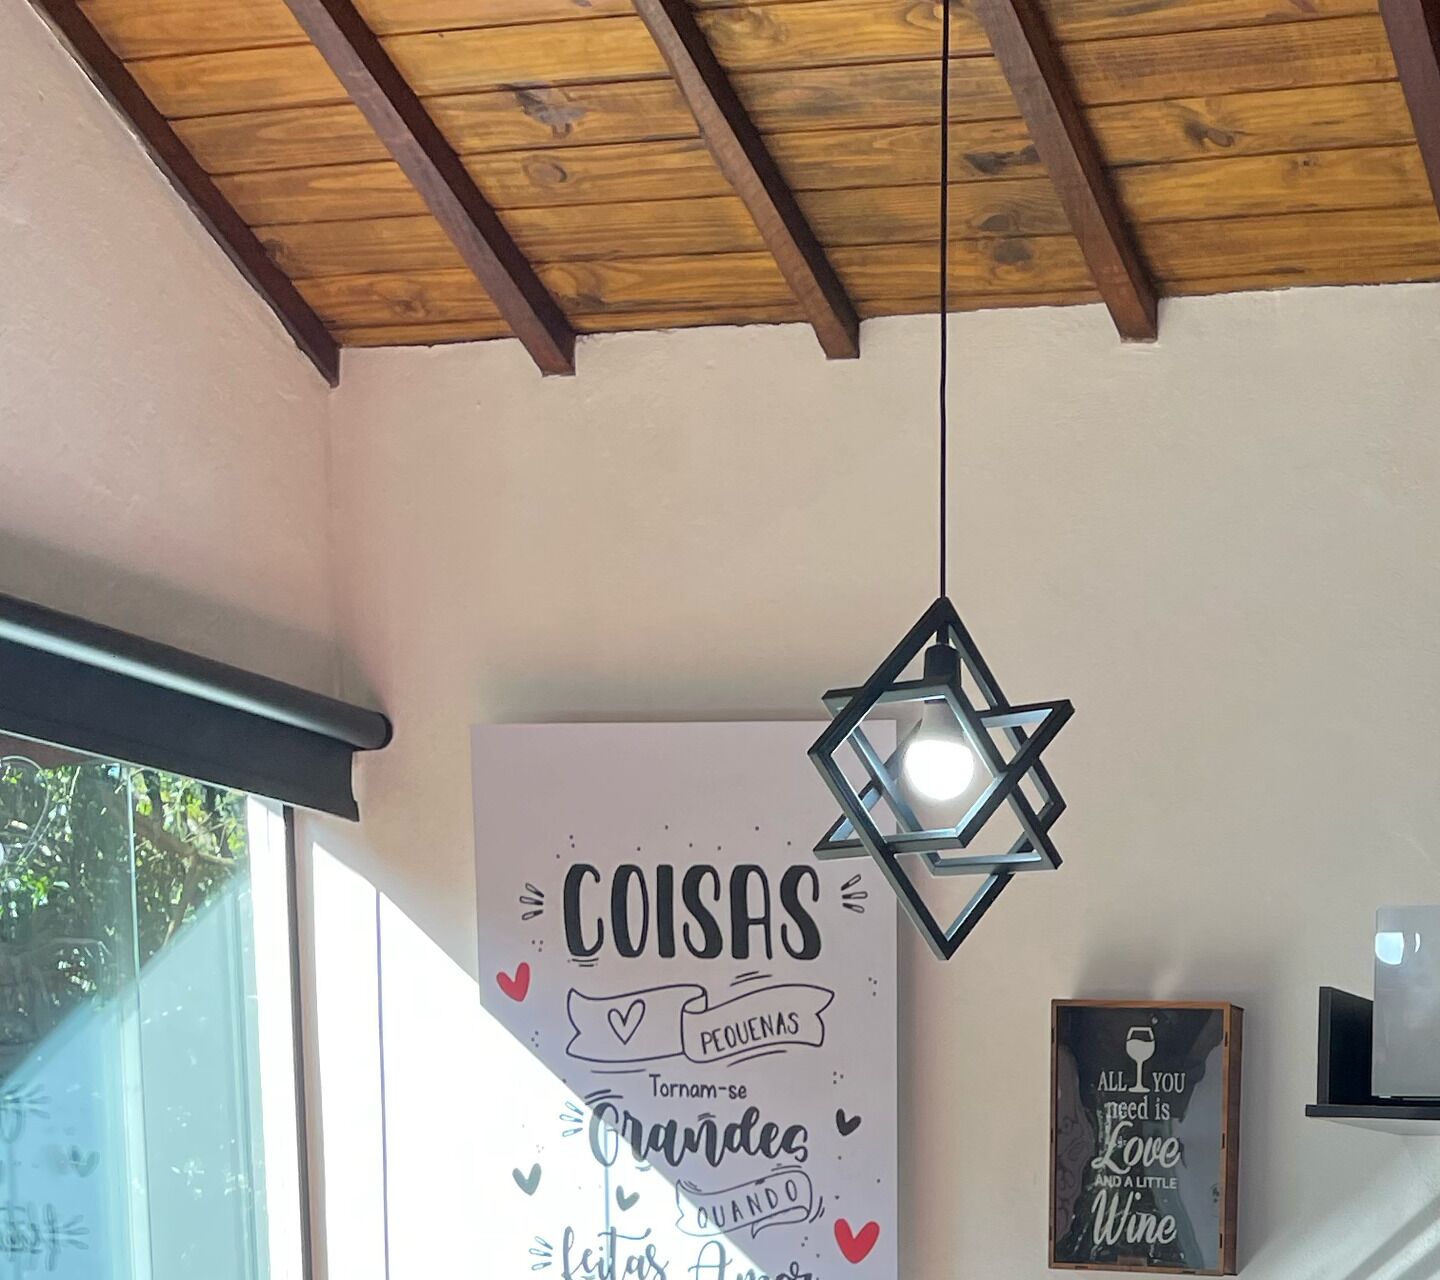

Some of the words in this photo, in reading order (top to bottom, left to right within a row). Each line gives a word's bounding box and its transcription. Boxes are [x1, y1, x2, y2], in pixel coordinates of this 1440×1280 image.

[563, 864, 821, 960] COISAS
[649, 1073, 748, 1099] Tornam-se
[1098, 1071, 1128, 1093] ALL
[1152, 1072, 1186, 1093] YOU
[1104, 1095, 1149, 1120] need
[1155, 1098, 1170, 1120] is
[588, 1101, 808, 1168] Grandes
[1091, 1120, 1182, 1174] Love
[1094, 1174, 1122, 1188] AND
[1124, 1175, 1133, 1188] A
[1136, 1175, 1177, 1189] LITTLE
[1091, 1189, 1177, 1245] Wine
